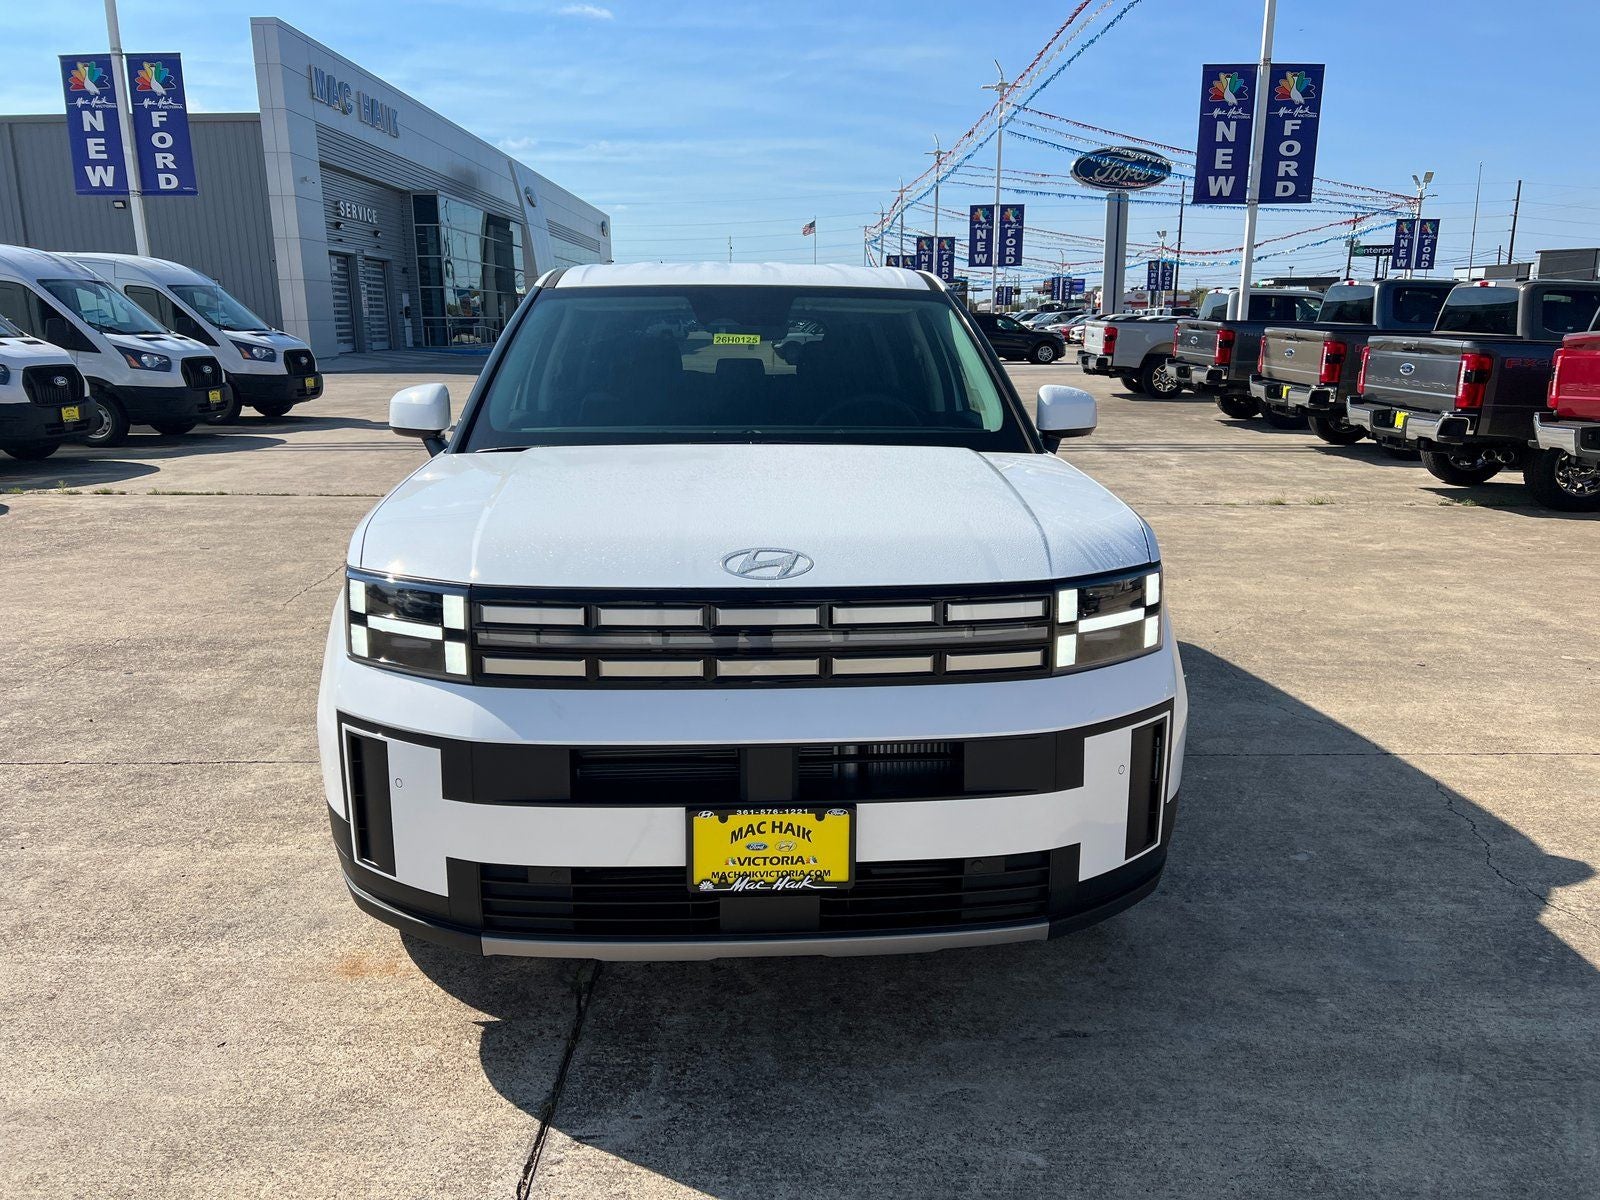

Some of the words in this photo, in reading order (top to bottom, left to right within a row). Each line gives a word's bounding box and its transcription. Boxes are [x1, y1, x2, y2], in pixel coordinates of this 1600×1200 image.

[309, 64, 353, 116] MAC
[357, 90, 399, 138] HAIK
[82, 110, 114, 187] NEW
[151, 111, 178, 190] FORD
[1208, 121, 1236, 196] NEW
[1275, 120, 1302, 196] FORD
[1094, 156, 1151, 180] Ford
[339, 200, 378, 224] SERVICE
[974, 230, 988, 264] NEW
[1006, 229, 1016, 264] FORD
[1396, 238, 1408, 268] NEW
[1420, 239, 1432, 268] FORD
[942, 254, 950, 280] FORD
[716, 336, 758, 344] 26H0125
[730, 821, 766, 844] MAC
[771, 820, 812, 842] HAIK
[711, 870, 831, 879] MACHAIKVICTORIACOM
[736, 855, 806, 866] VICTORIA
[730, 876, 771, 892] Mac
[772, 876, 818, 890] Haik
